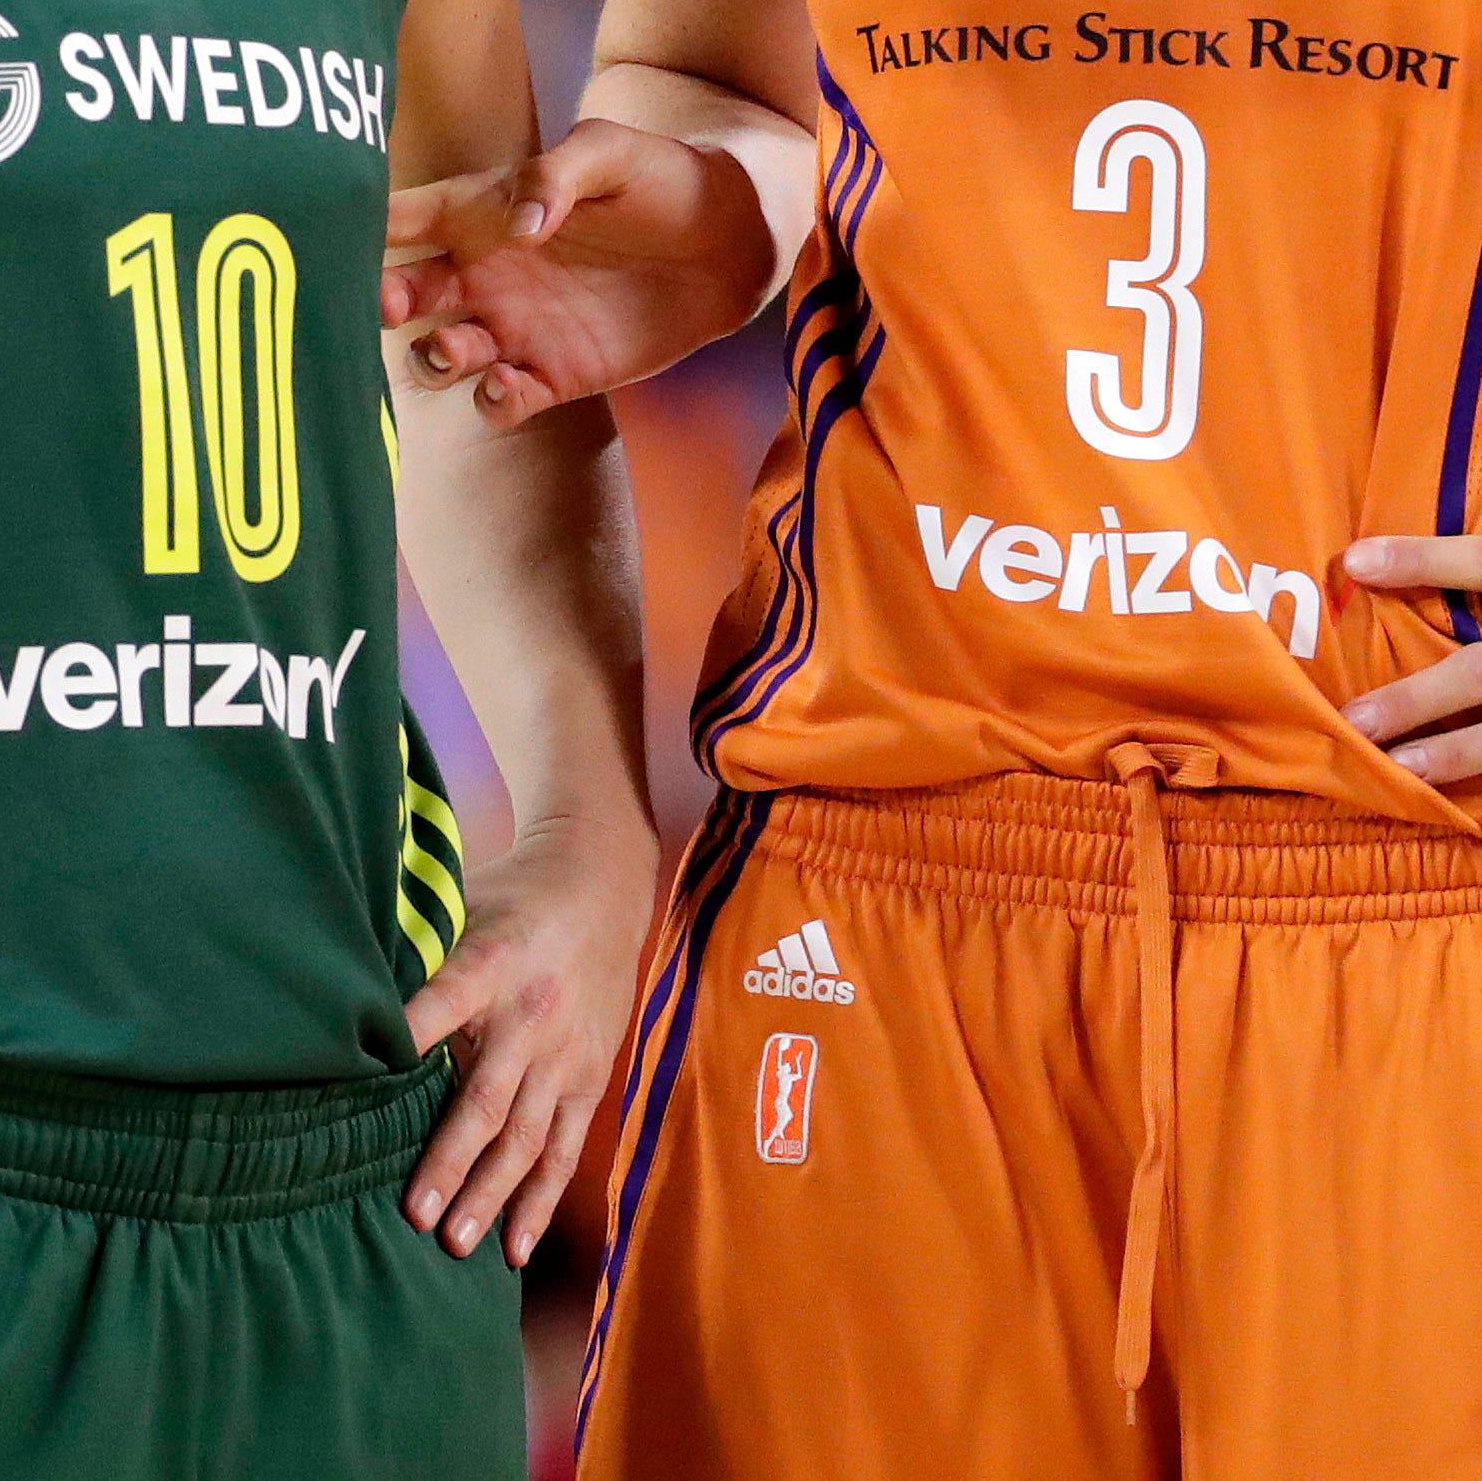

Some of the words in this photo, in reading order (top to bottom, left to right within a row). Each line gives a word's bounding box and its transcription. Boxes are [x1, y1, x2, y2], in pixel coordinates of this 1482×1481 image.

[59, 32, 386, 153] SWEDISH
[856, 22, 1051, 75] TALKING
[1074, 12, 1230, 68] STICK
[1248, 17, 1460, 91] RESORT
[1065, 98, 1208, 461] 3
[106, 212, 301, 583] 10
[914, 505, 1321, 660] verizon
[743, 968, 856, 1005] adidas
